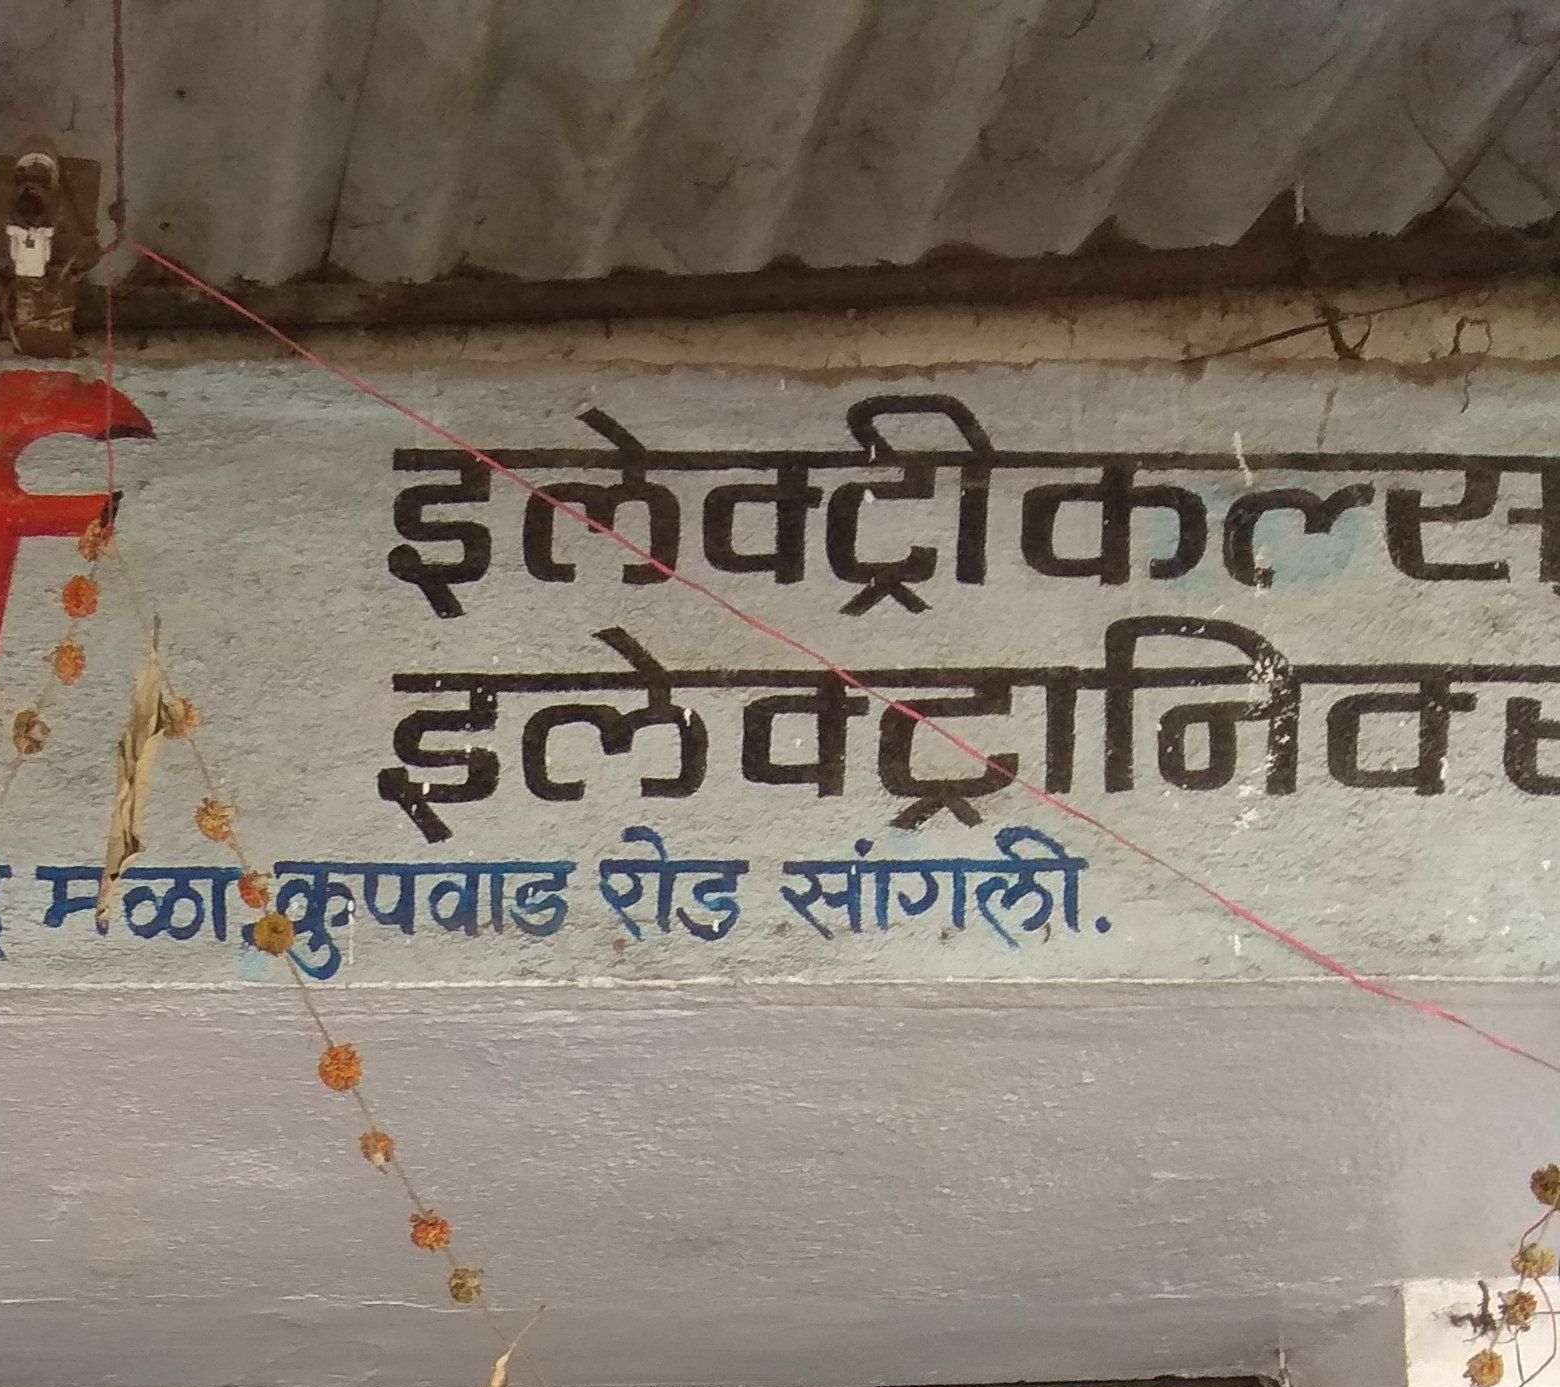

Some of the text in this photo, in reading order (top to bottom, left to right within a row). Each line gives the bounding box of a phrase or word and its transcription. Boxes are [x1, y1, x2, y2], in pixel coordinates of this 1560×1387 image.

[273, 858, 577, 980] कुपवाड
[599, 826, 750, 942] रोड
[780, 826, 1112, 950] सांगली.
